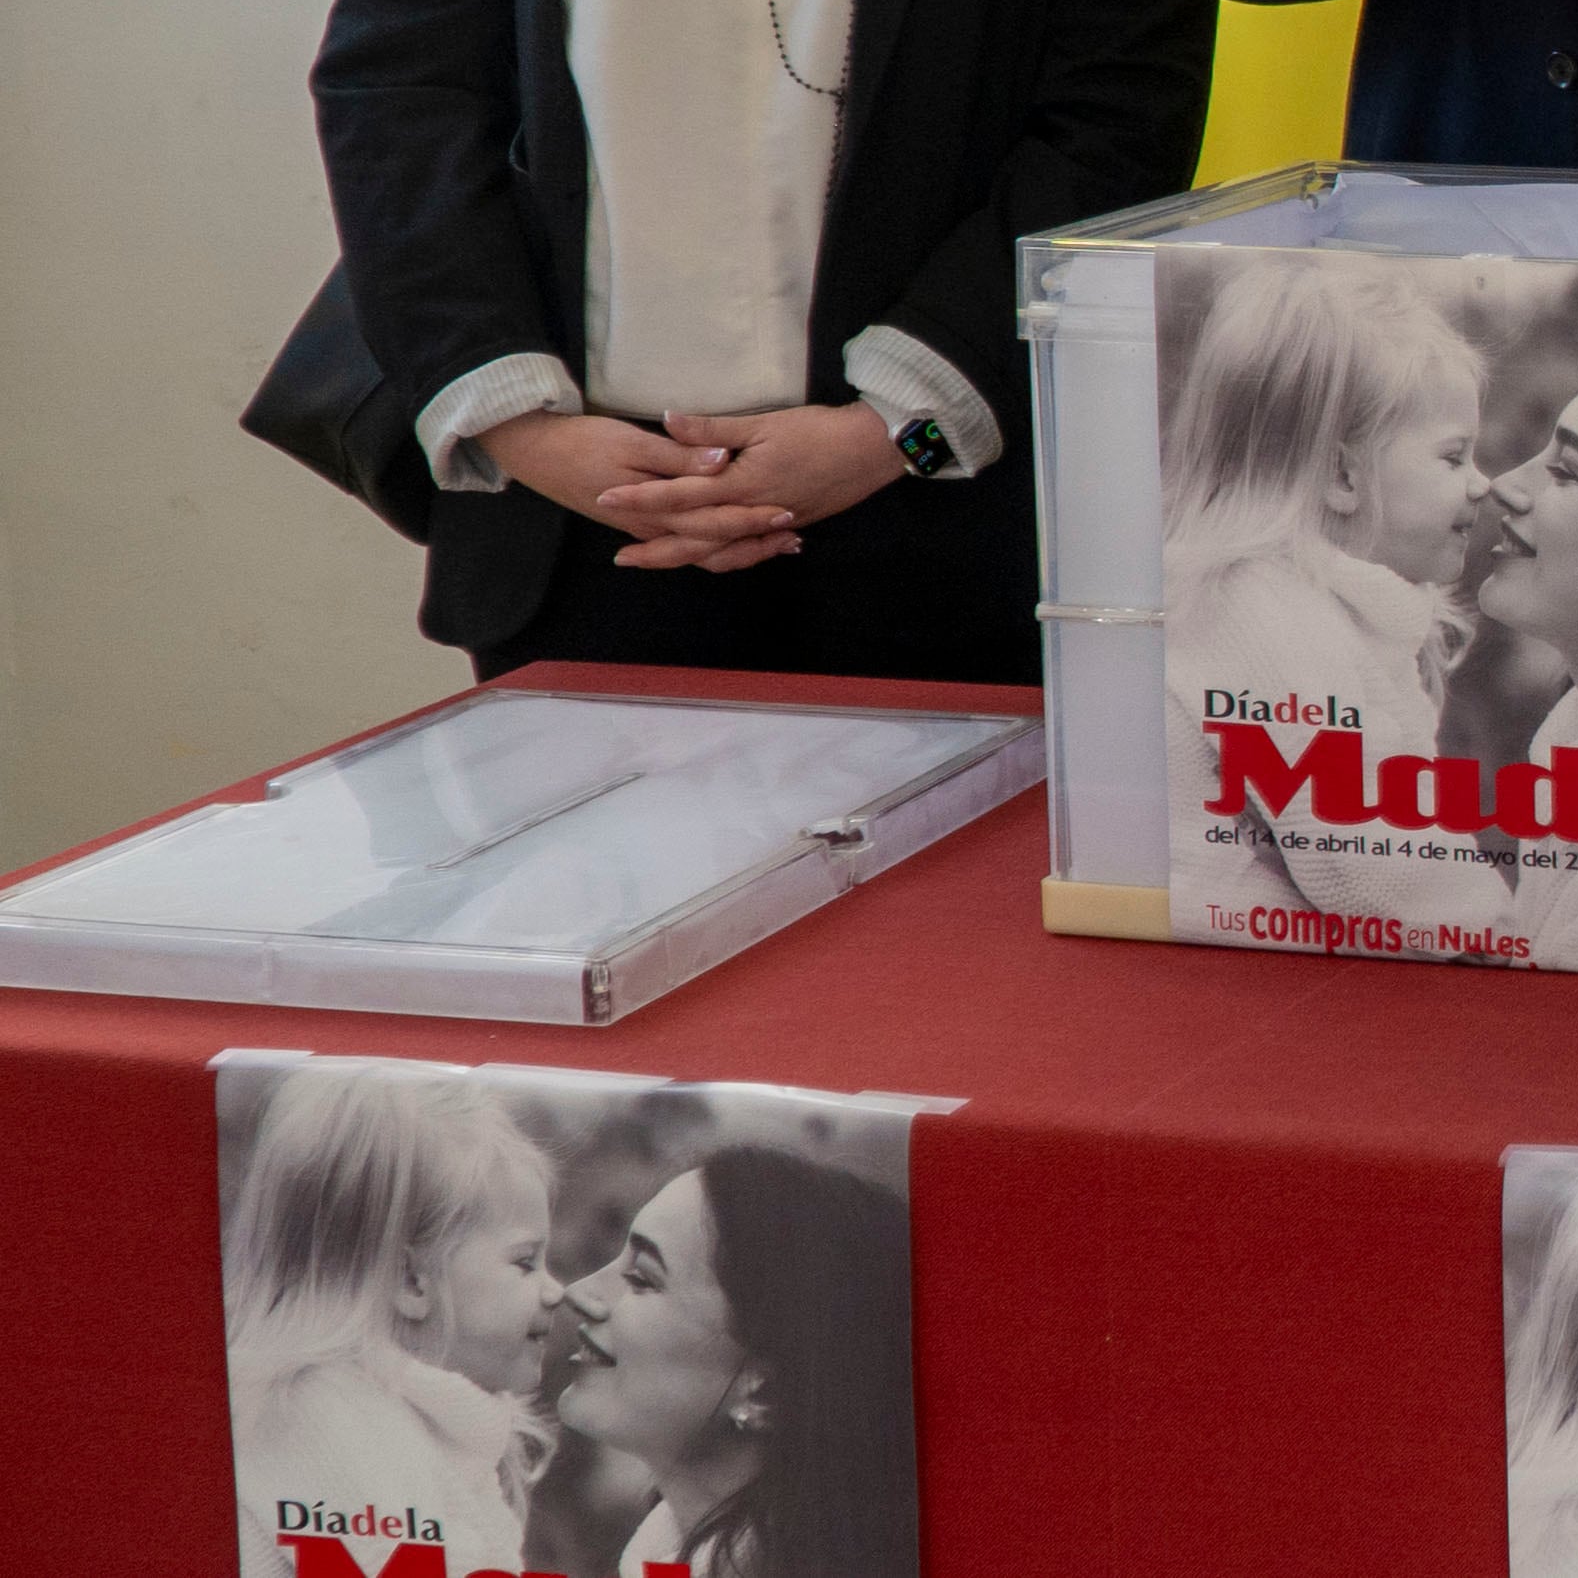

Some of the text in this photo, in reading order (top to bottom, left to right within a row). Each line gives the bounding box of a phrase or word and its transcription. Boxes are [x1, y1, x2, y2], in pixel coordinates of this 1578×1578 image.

[1205, 827, 1240, 846] del
[1247, 827, 1276, 848] 14
[1281, 831, 1308, 850] de
[1315, 833, 1366, 856] abril
[1371, 836, 1391, 857] al
[1397, 842, 1412, 858] 4
[1419, 841, 1447, 862] de
[1453, 847, 1515, 868] mayo
[1523, 848, 1558, 868] del
[1206, 904, 1530, 959] Tus compras en Nules
